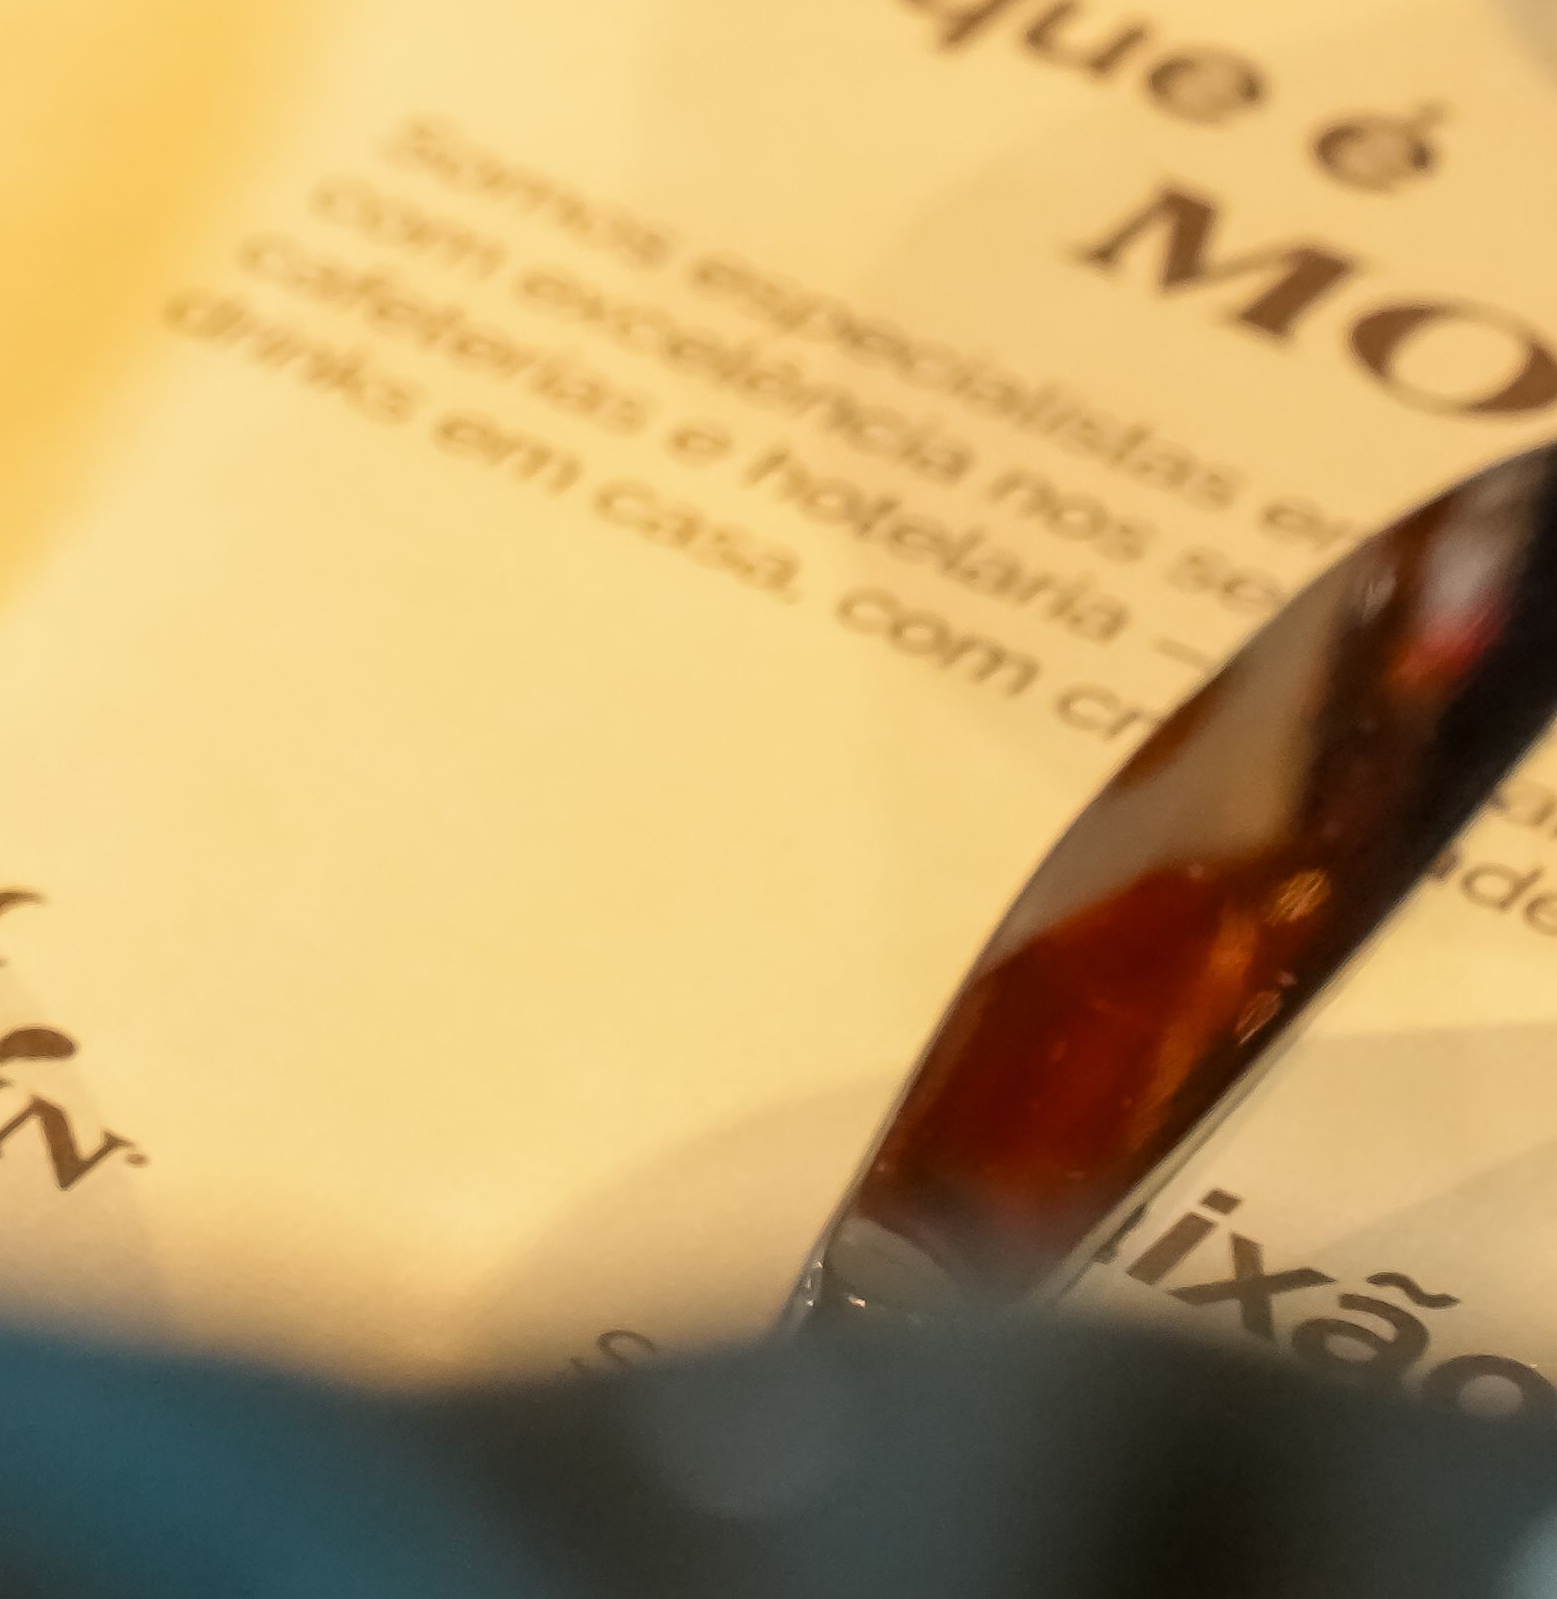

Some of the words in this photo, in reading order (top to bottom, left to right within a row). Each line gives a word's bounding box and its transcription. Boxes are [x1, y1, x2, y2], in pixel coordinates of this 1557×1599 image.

[1313, 100, 1449, 193] é
[167, 291, 420, 425] drinks
[436, 411, 583, 498] em
[838, 588, 1042, 696] com
[239, 236, 648, 433] cafeterias
[668, 423, 735, 473] e
[745, 445, 1128, 643] hotelaria
[312, 179, 503, 283] com
[991, 470, 1153, 563] nos
[692, 255, 1237, 507] especialistas
